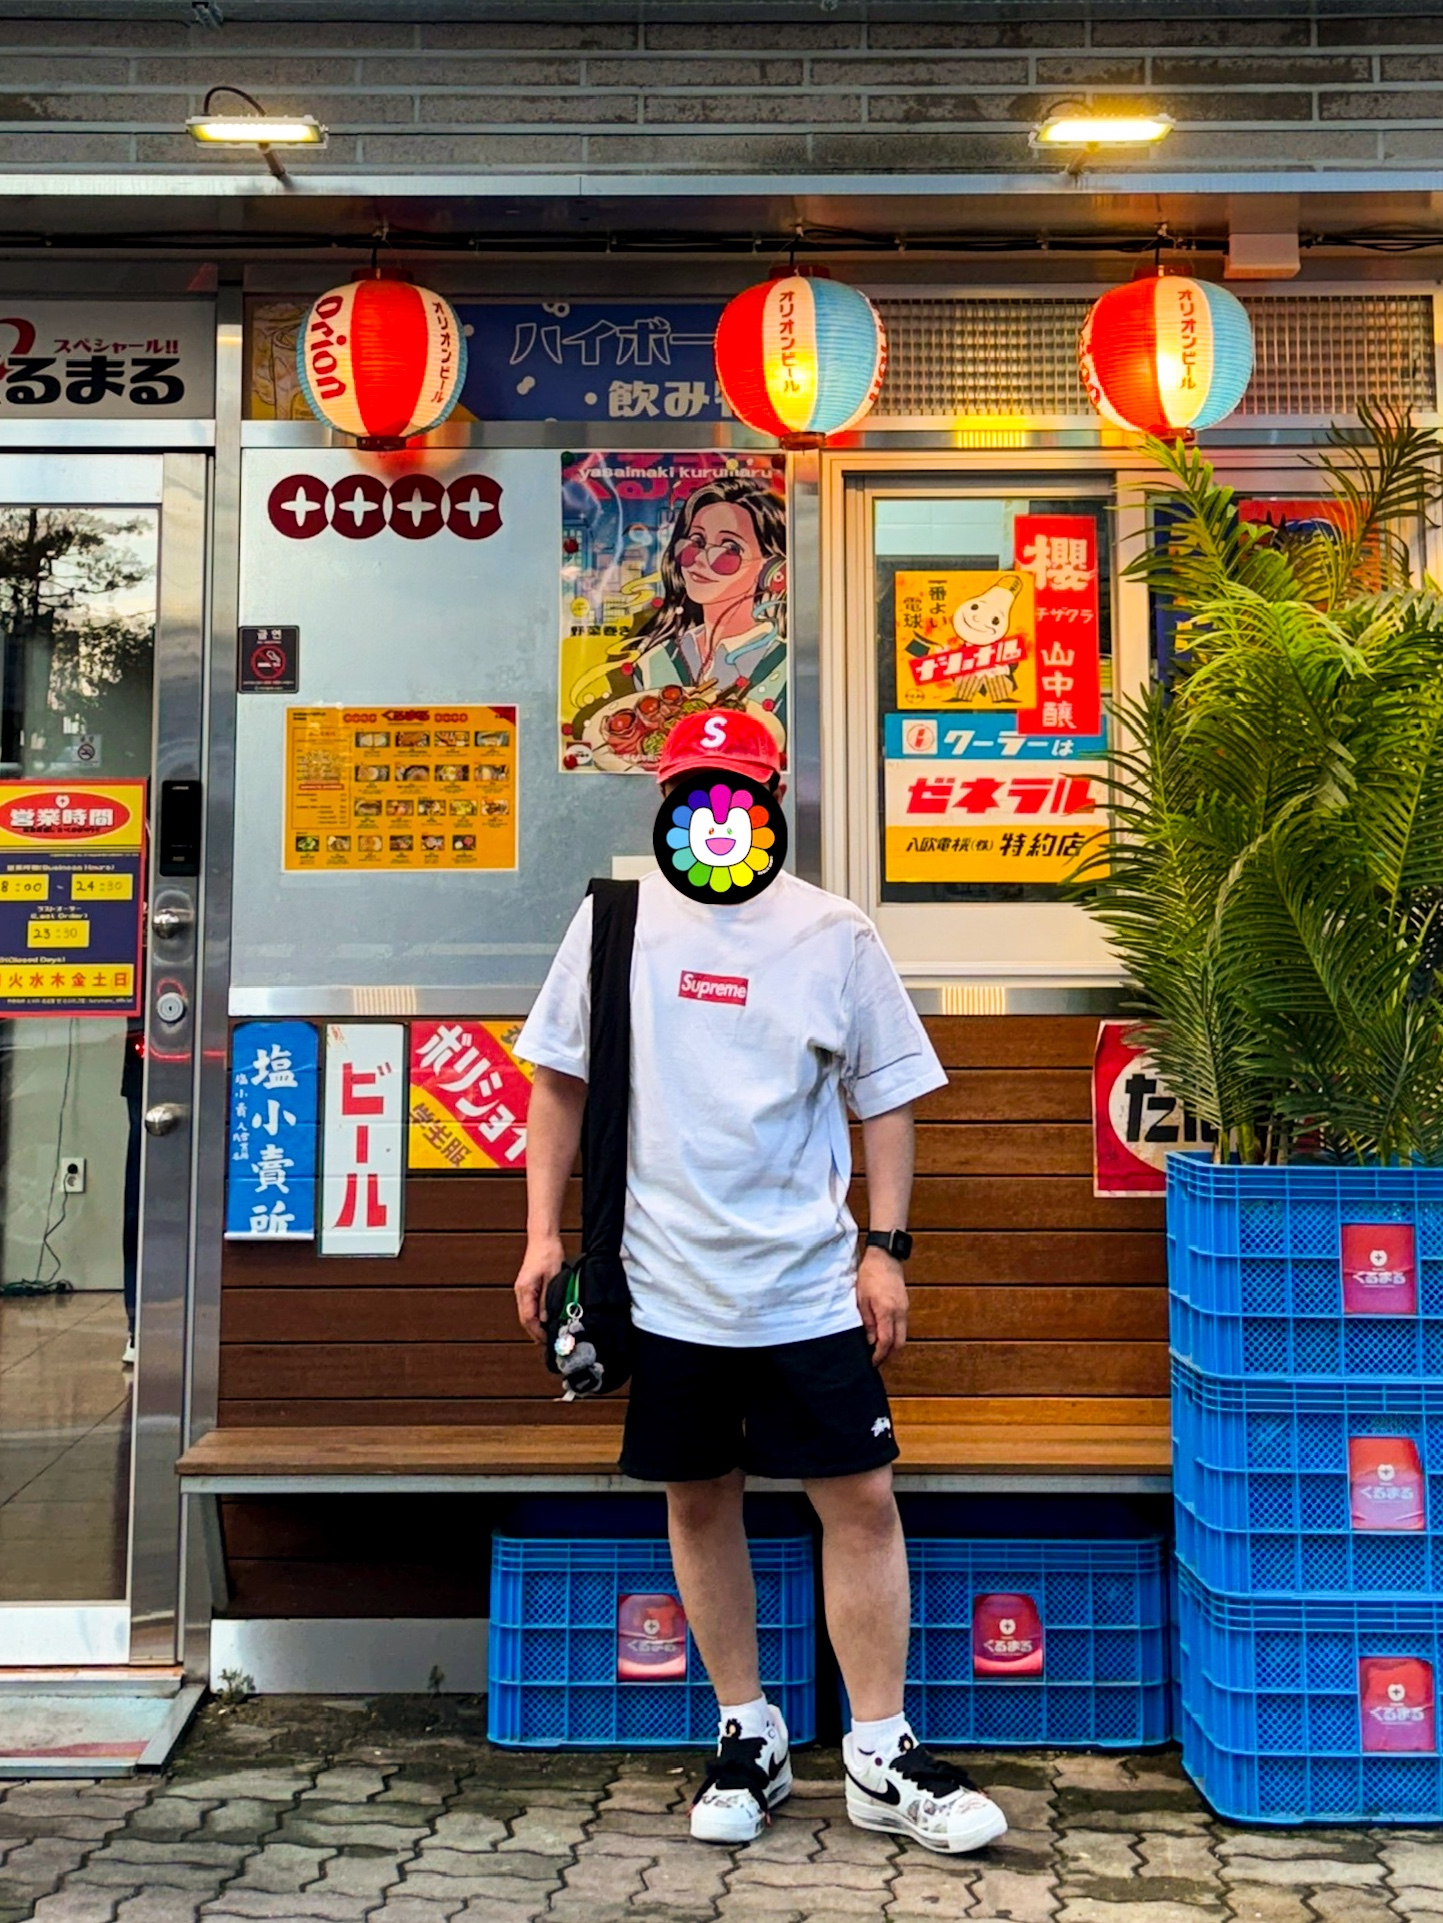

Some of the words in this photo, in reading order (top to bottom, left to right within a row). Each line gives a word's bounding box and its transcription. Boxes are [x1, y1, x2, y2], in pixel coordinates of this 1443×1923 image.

[53, 338, 179, 354] スペシャール!!
[310, 295, 347, 400] Orion
[432, 302, 452, 404] オリオンビール
[779, 291, 800, 393] オリオンビール
[1177, 289, 1197, 390] オリオンビール
[0, 355, 185, 405] るまる
[578, 466, 674, 481] yasaimaki
[679, 465, 773, 481] kurumaru
[903, 597, 922, 629] 電球
[928, 579, 948, 629] 一番よい
[700, 716, 728, 748] S
[943, 729, 1074, 757] クーラーは
[906, 778, 1096, 814] ゼネラル
[10, 808, 114, 827] 営業時間
[1000, 832, 1085, 857] 特約店
[681, 973, 747, 998] Supreme
[334, 1062, 392, 1228] ビール
